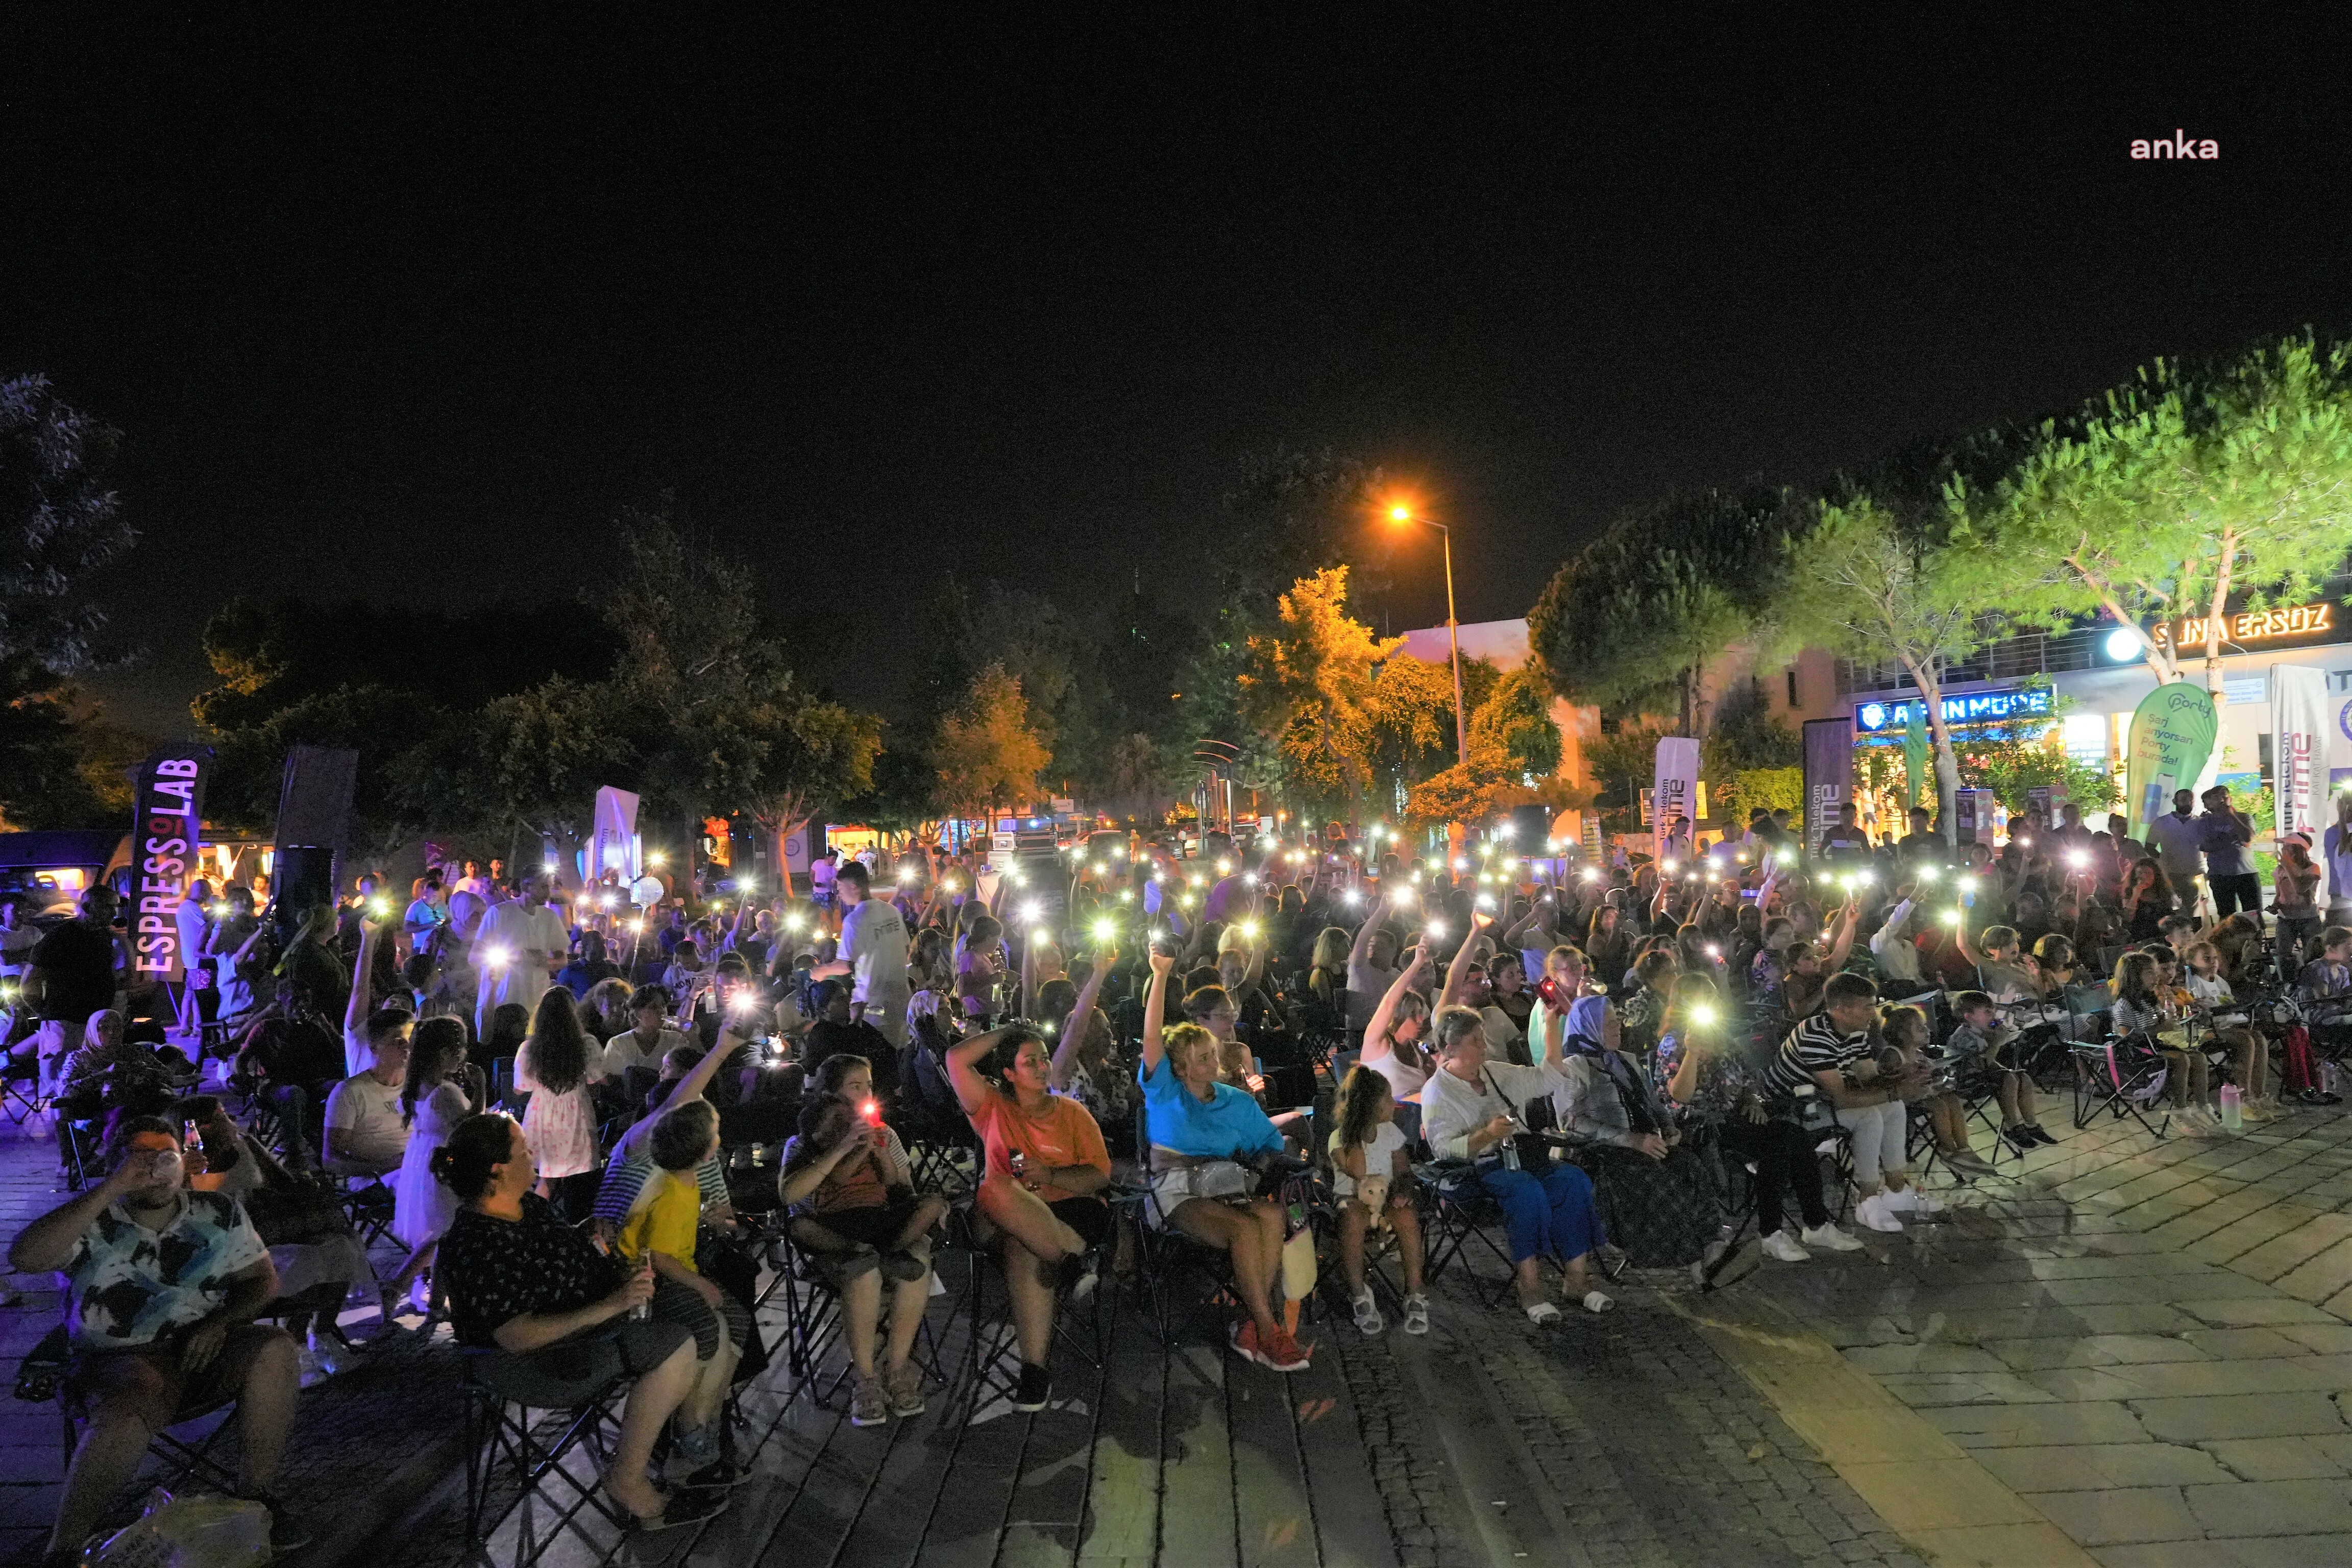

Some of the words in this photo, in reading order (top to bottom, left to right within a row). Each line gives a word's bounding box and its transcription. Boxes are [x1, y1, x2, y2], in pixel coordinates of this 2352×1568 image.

[2148, 714, 2169, 728] Şarj
[2141, 737, 2170, 752] Porty
[2137, 748, 2178, 765] burada!
[1659, 779, 1669, 818] Telekom
[1810, 785, 1821, 832] Telekom
